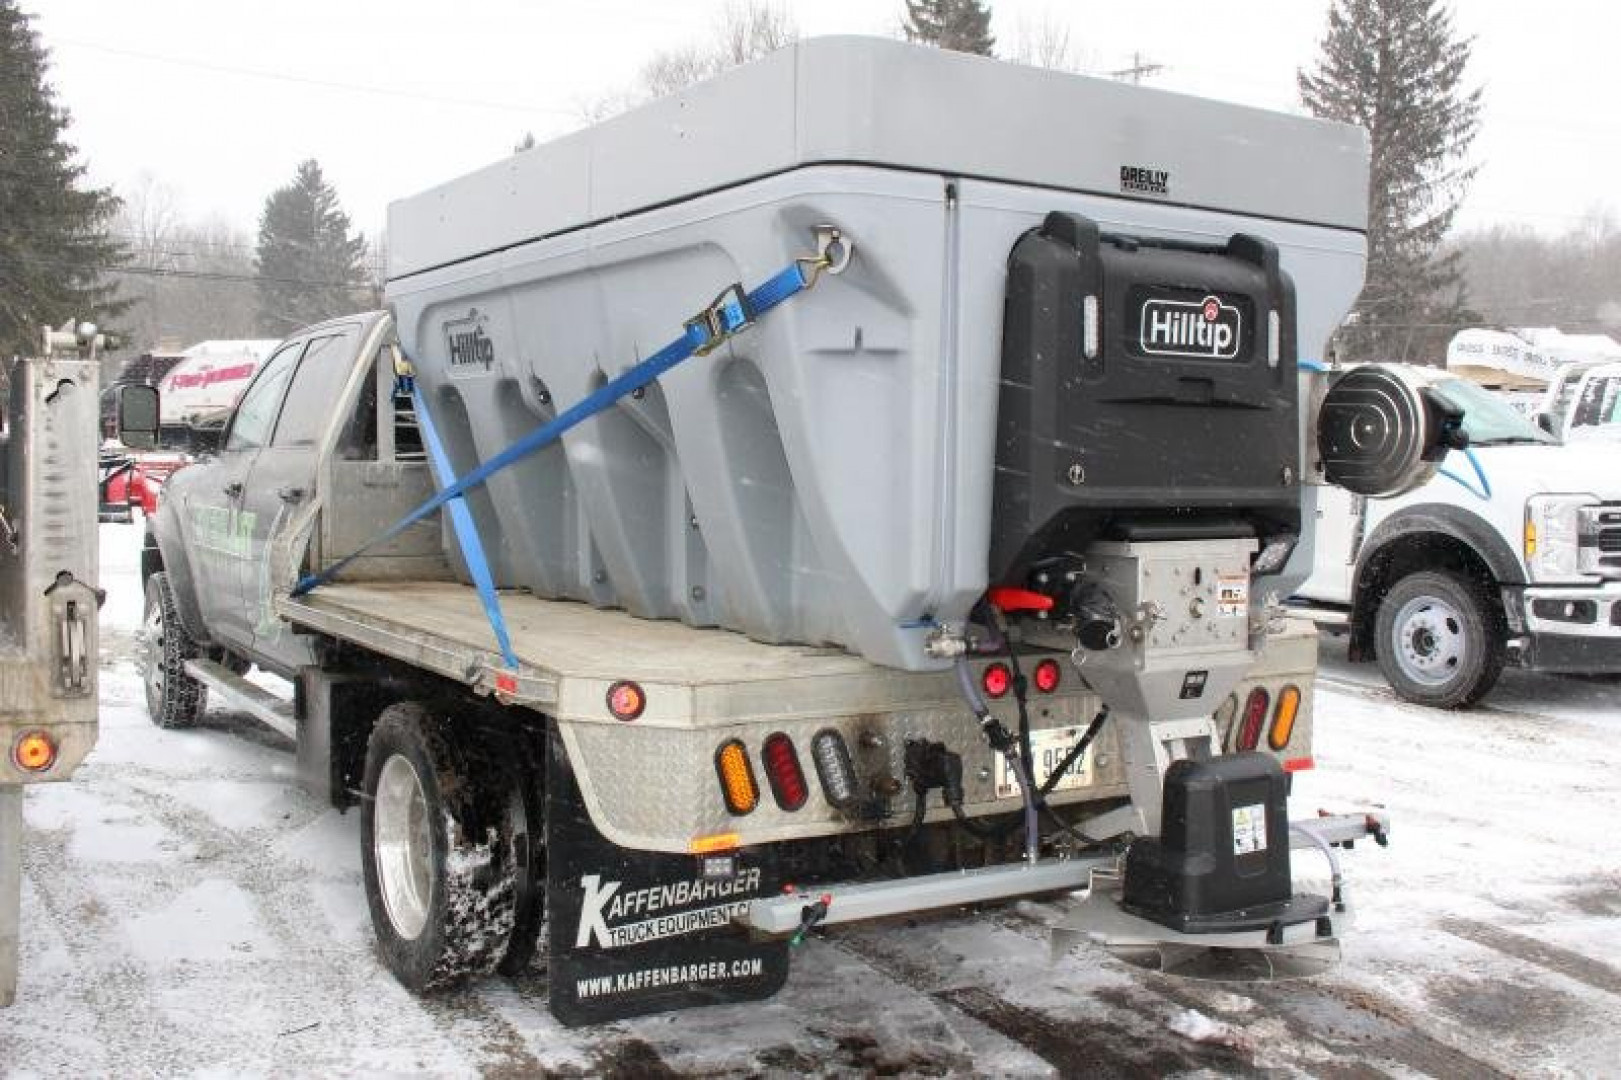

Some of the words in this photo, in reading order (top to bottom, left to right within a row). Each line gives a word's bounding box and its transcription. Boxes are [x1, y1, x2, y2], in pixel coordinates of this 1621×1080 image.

[1151, 309, 1232, 356] Hilltip
[576, 867, 761, 948] KAFFENBARGER
[609, 918, 655, 946] TRUCK
[577, 957, 763, 998] WWW.KAFFENBARGER.COM
